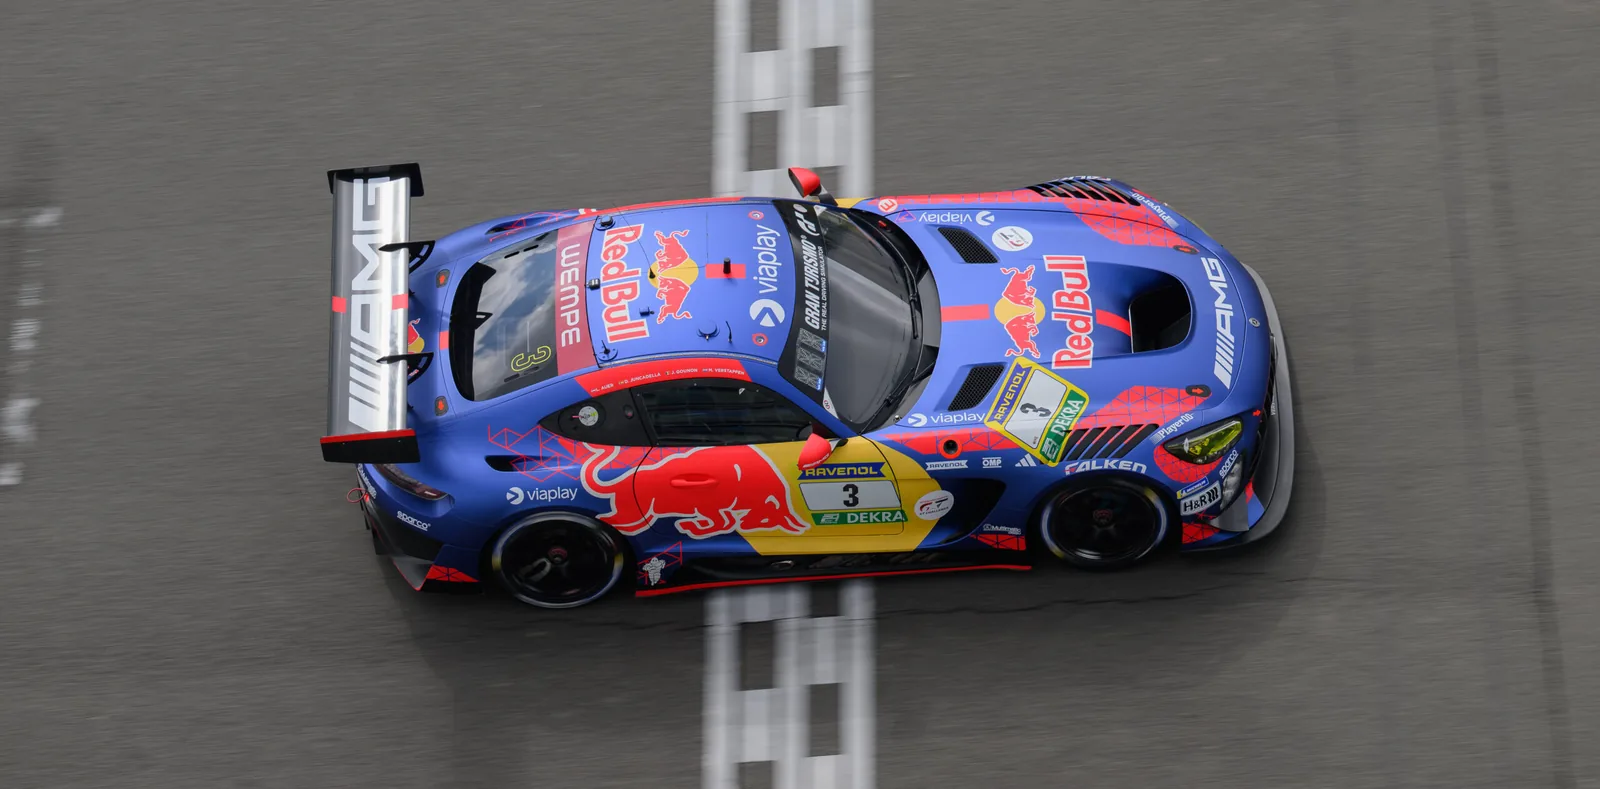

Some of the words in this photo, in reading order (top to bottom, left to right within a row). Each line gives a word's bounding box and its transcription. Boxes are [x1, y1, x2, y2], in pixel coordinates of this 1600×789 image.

[919, 212, 973, 225] viaplay
[350, 176, 392, 353] AMG
[753, 224, 782, 294] viaplay
[560, 243, 581, 348] WEMPE
[1200, 257, 1235, 344] AMG
[805, 289, 820, 330] GRAN
[510, 345, 552, 372] 3
[994, 369, 1027, 421] RAVENOL
[930, 412, 986, 424] viaplay
[1019, 402, 1052, 418] 3
[1051, 399, 1084, 438] DEKRA
[805, 465, 879, 478] RAVENOL
[929, 461, 965, 470] RAVENOL
[982, 458, 1002, 467] OMP
[1064, 459, 1148, 476] FALKEN
[526, 486, 578, 502] viaplay
[842, 483, 860, 508] 3
[846, 510, 905, 524] DEKRA
